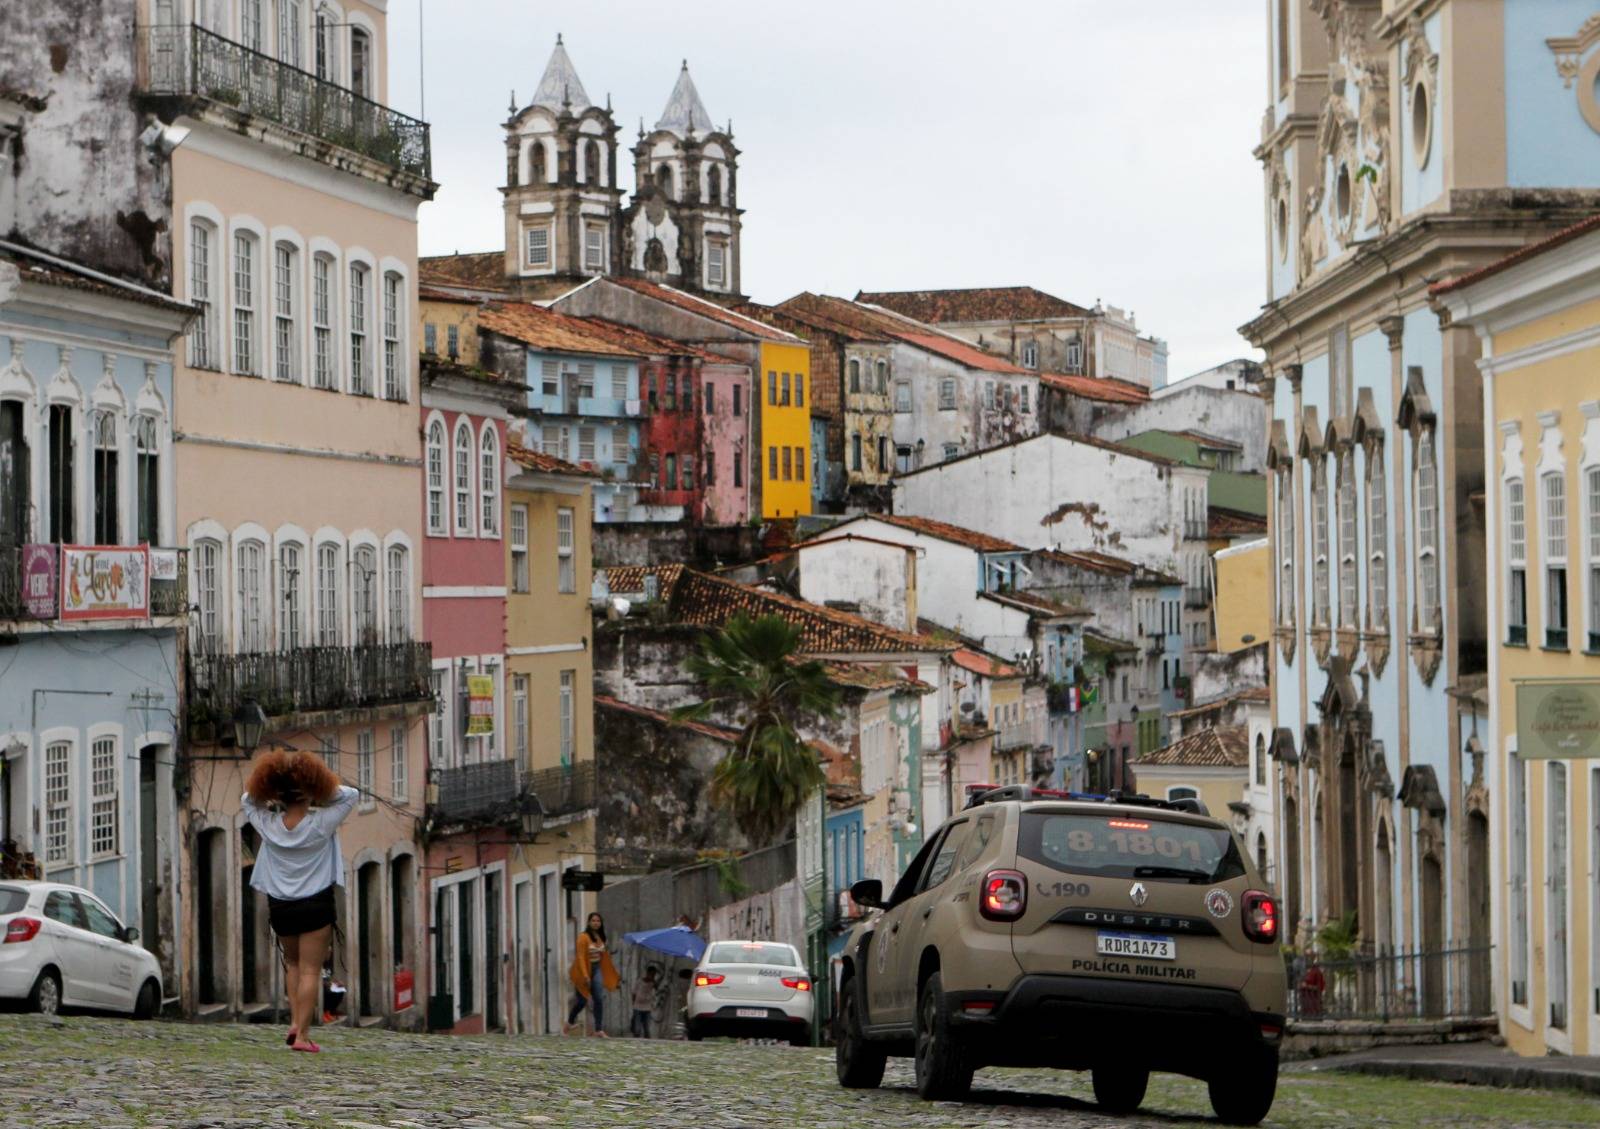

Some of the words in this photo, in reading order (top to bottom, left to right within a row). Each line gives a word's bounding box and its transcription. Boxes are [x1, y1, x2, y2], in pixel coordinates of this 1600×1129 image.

[1068, 829, 1201, 862] 8.1801
[1052, 882, 1090, 897] 190
[1085, 912, 1190, 928] DUSTER
[1105, 938, 1168, 956] RDR1A73
[1072, 958, 1130, 974] POLÍCIA
[1135, 963, 1196, 979] MILITAR
